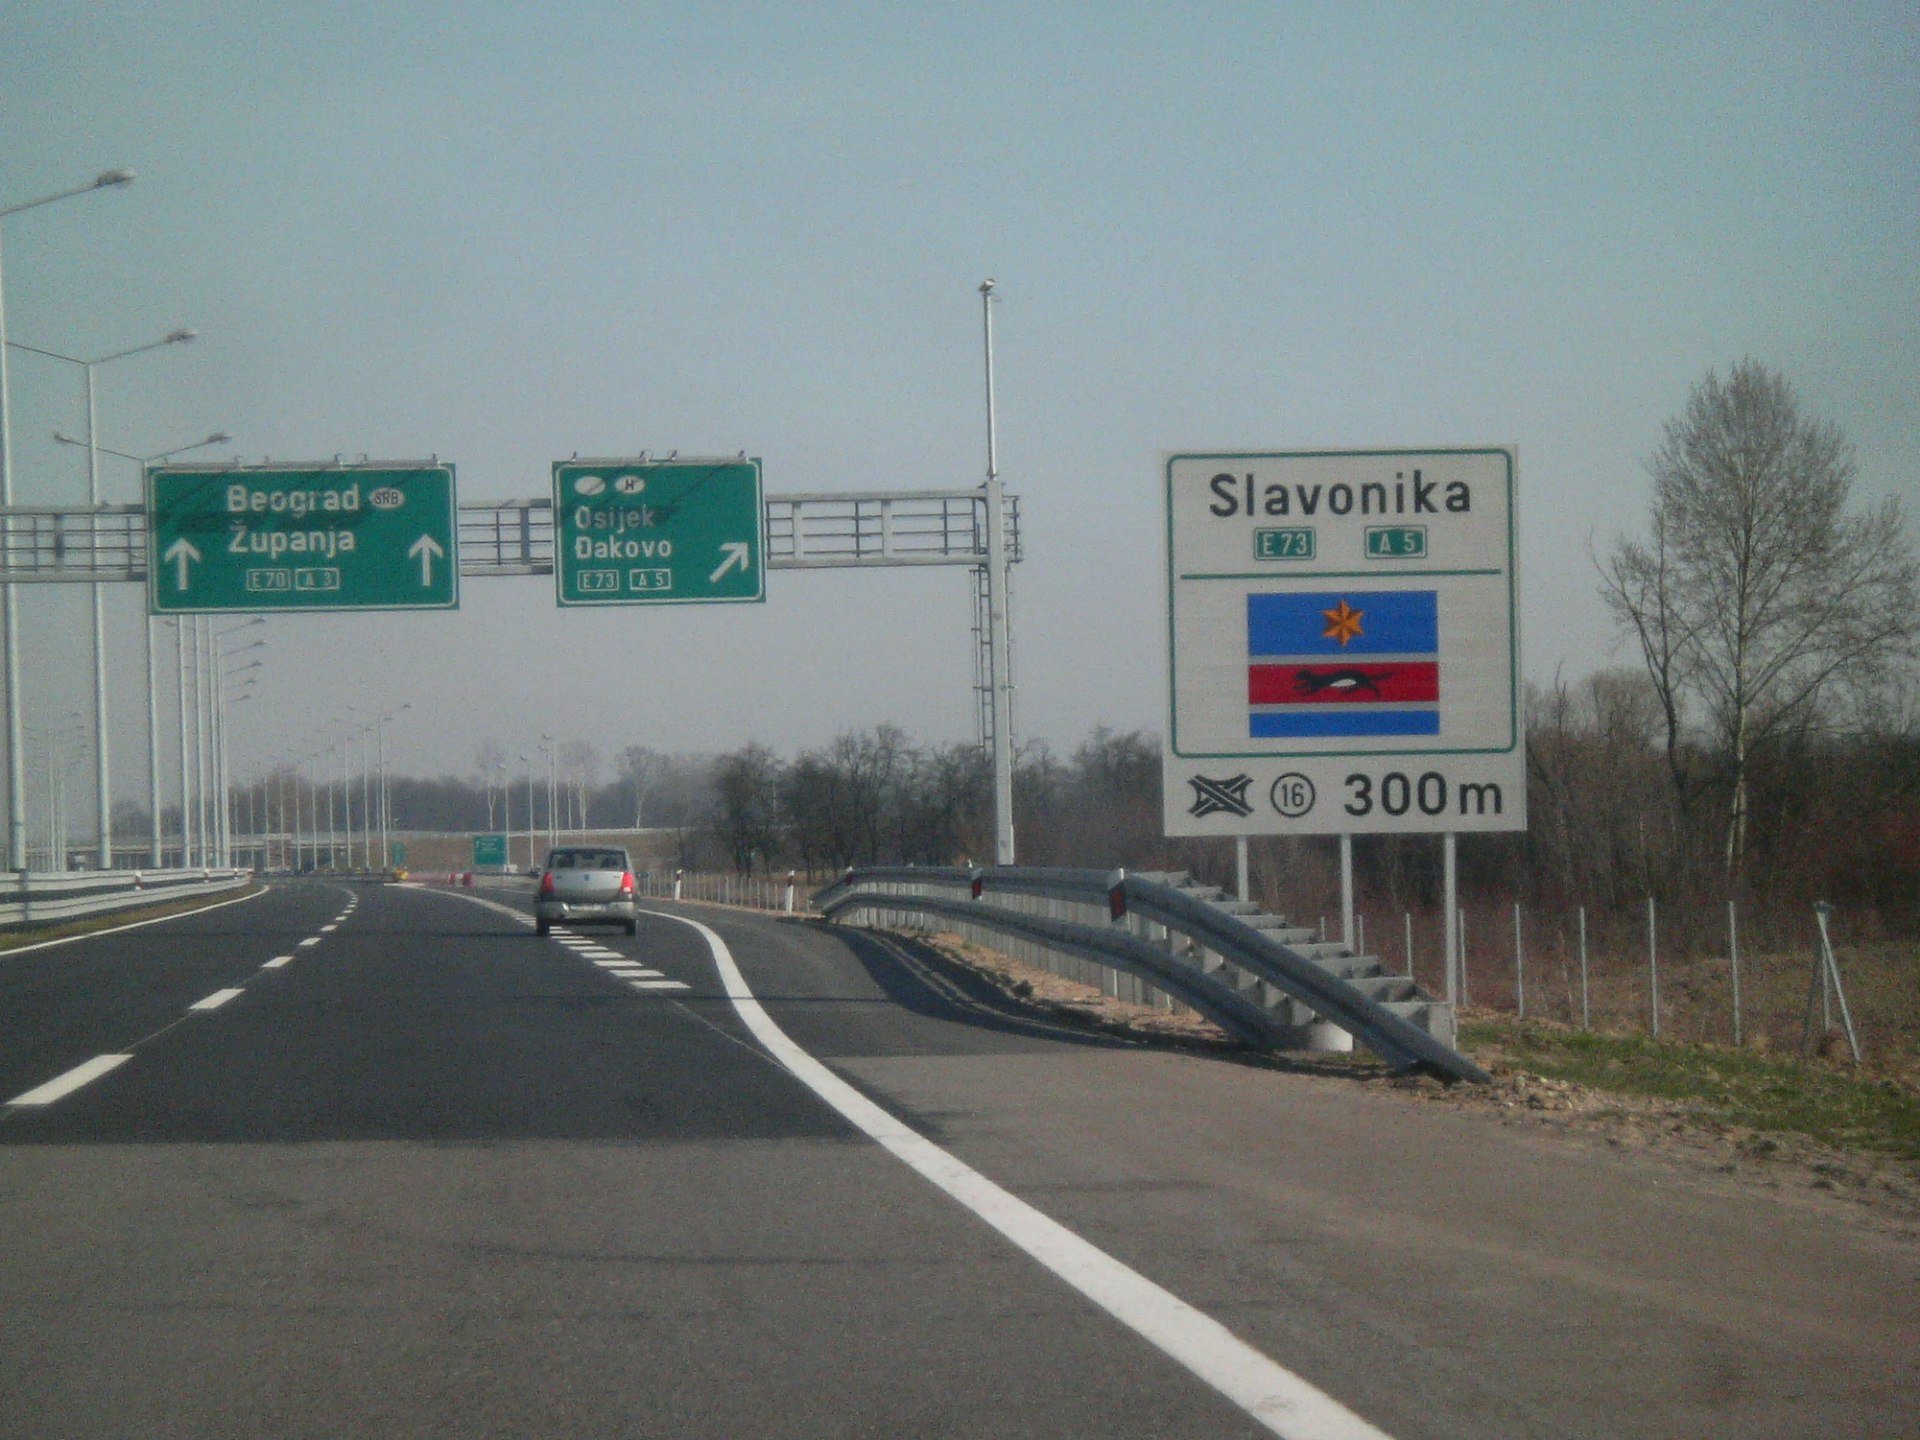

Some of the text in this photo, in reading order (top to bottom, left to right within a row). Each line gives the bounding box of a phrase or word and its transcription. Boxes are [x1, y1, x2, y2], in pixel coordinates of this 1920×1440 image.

[625, 479, 634, 490] H
[1209, 469, 1471, 517] Slavonika
[227, 482, 360, 518] Beograd
[373, 491, 399, 505] SRB
[575, 504, 655, 534] Osijek
[228, 520, 355, 559] Županja
[1264, 533, 1307, 555] E 73
[1380, 531, 1414, 553] A 5
[252, 572, 285, 588] E 70
[305, 572, 332, 586] A 3
[584, 573, 613, 588] E 73
[639, 572, 664, 586] A 5
[1281, 783, 1304, 807] 16
[1344, 771, 1502, 816] 300 m
